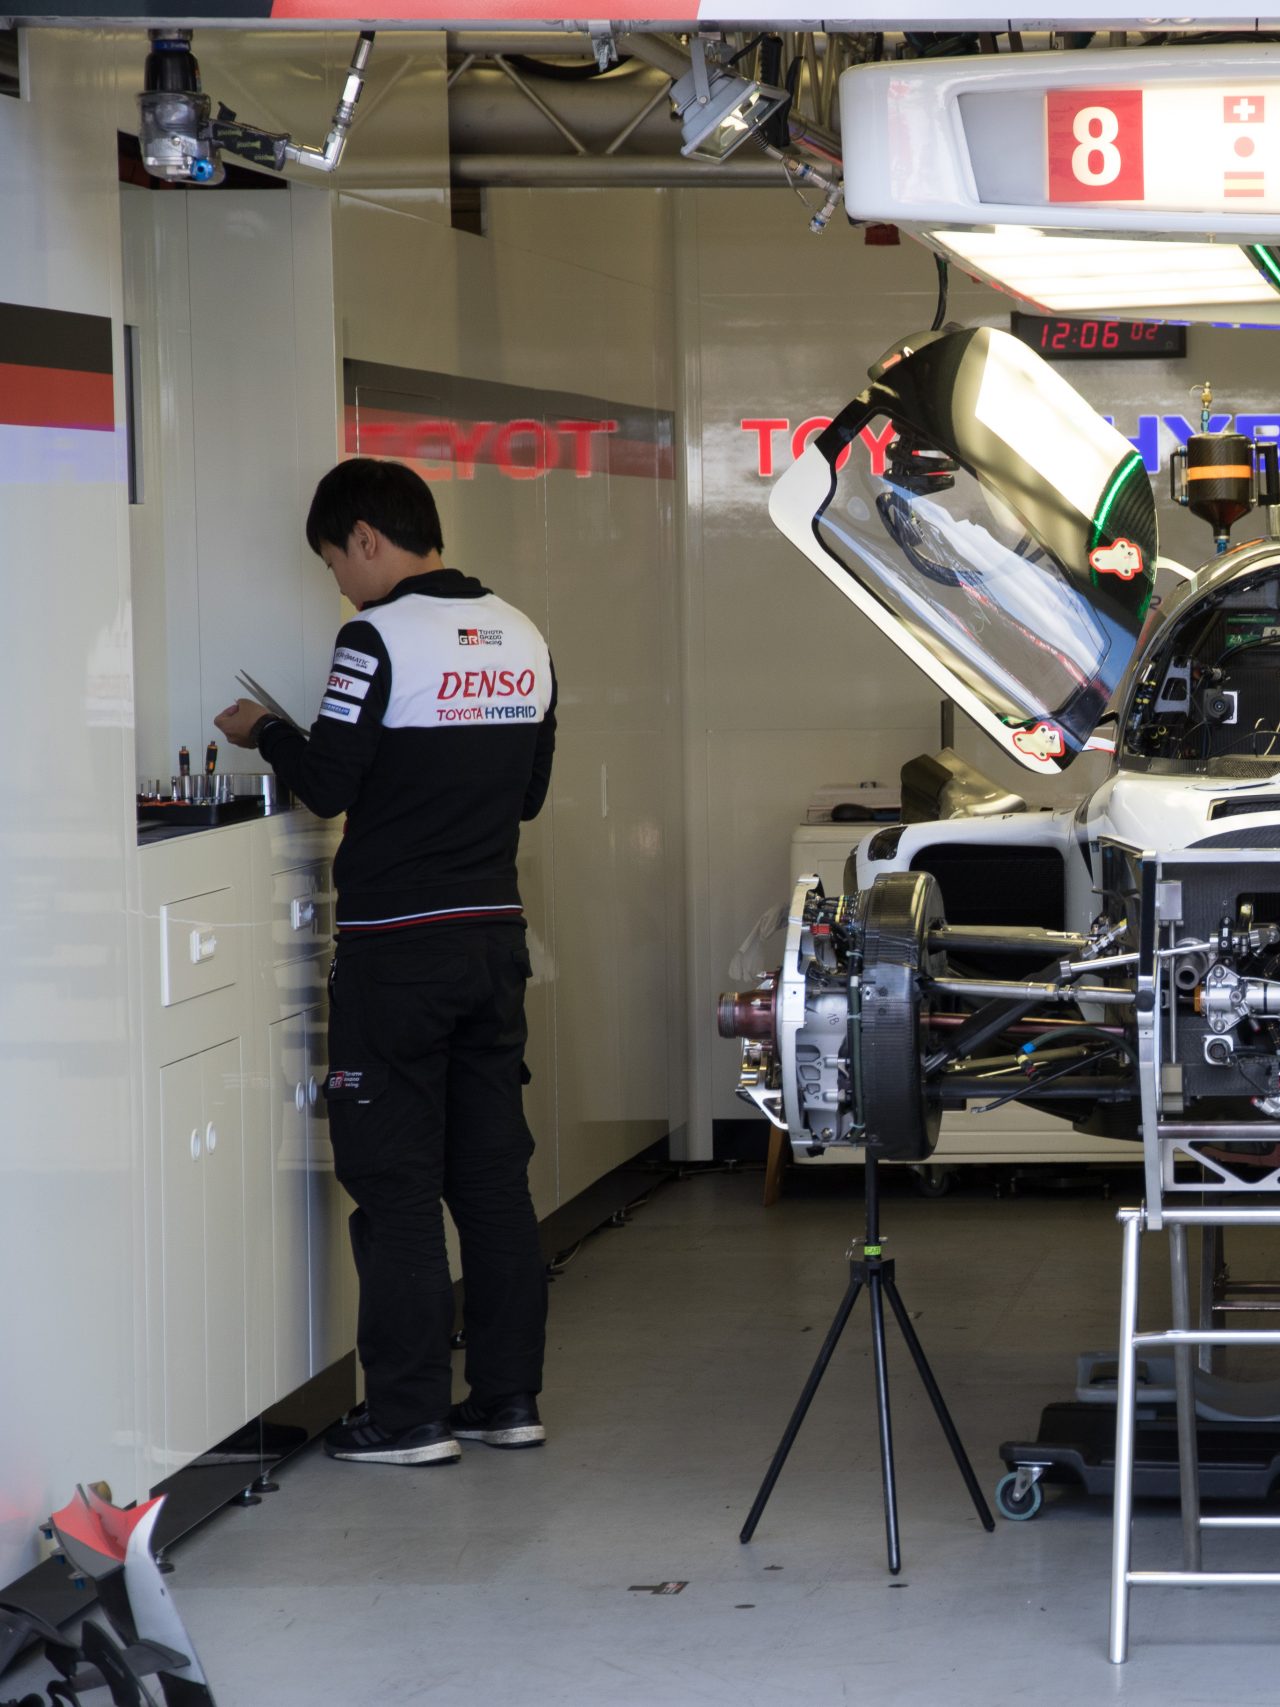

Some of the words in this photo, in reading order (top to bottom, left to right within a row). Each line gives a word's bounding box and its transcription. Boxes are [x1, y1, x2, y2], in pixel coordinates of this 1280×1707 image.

[1071, 106, 1122, 187] 8
[1040, 321, 1120, 349] 12:06
[1129, 321, 1159, 341] 02
[328, 675, 353, 690] ENT
[436, 668, 536, 701] DENSO
[436, 707, 484, 721] TOYOTA
[485, 705, 537, 720] HYBRID
